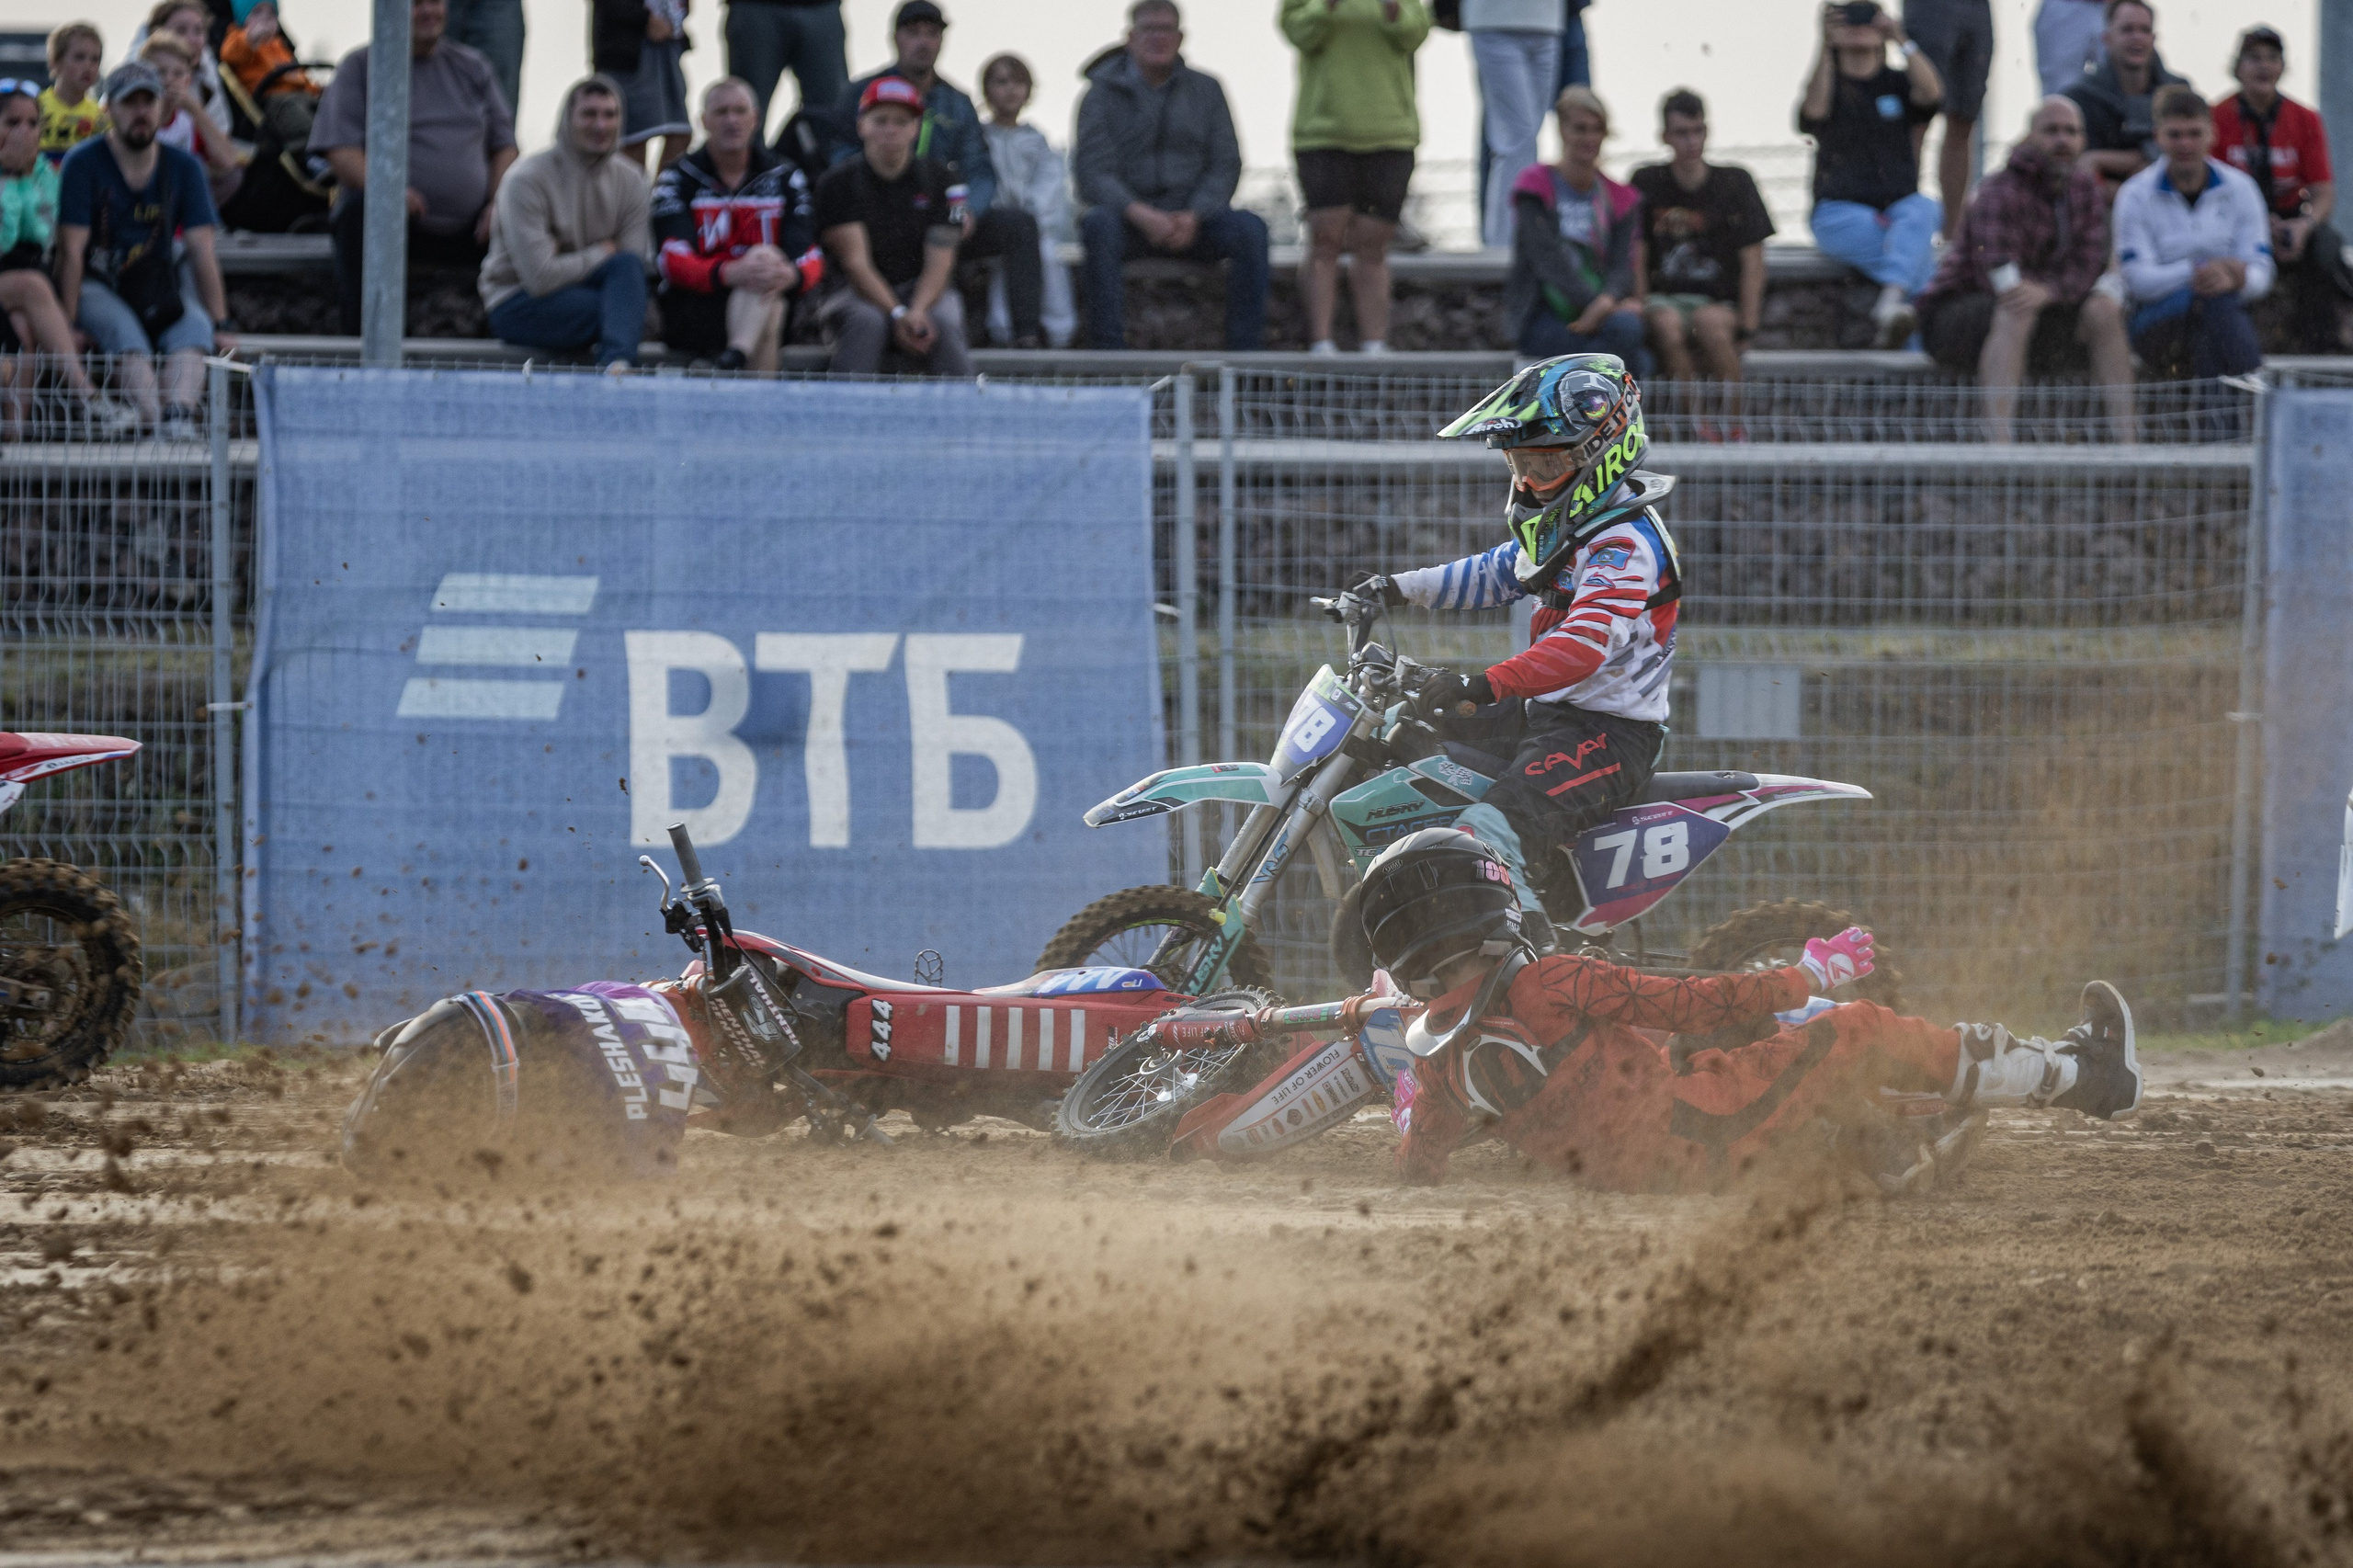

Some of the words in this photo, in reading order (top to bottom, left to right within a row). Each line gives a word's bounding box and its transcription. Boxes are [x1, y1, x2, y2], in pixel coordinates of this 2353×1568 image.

[1612, 404, 1628, 426] IT
[624, 630, 1038, 849] ВТБ
[1365, 800, 1425, 822] HUSKY
[1594, 821, 1689, 890] 78
[1472, 859, 1515, 891] 100
[748, 971, 800, 1045] RENTHAL
[714, 998, 766, 1067] RENTHAL
[871, 999, 892, 1062] 444
[1304, 1049, 1340, 1079] FLOWER
[1271, 1087, 1291, 1105] LIFE
[1291, 1076, 1305, 1091] OF
